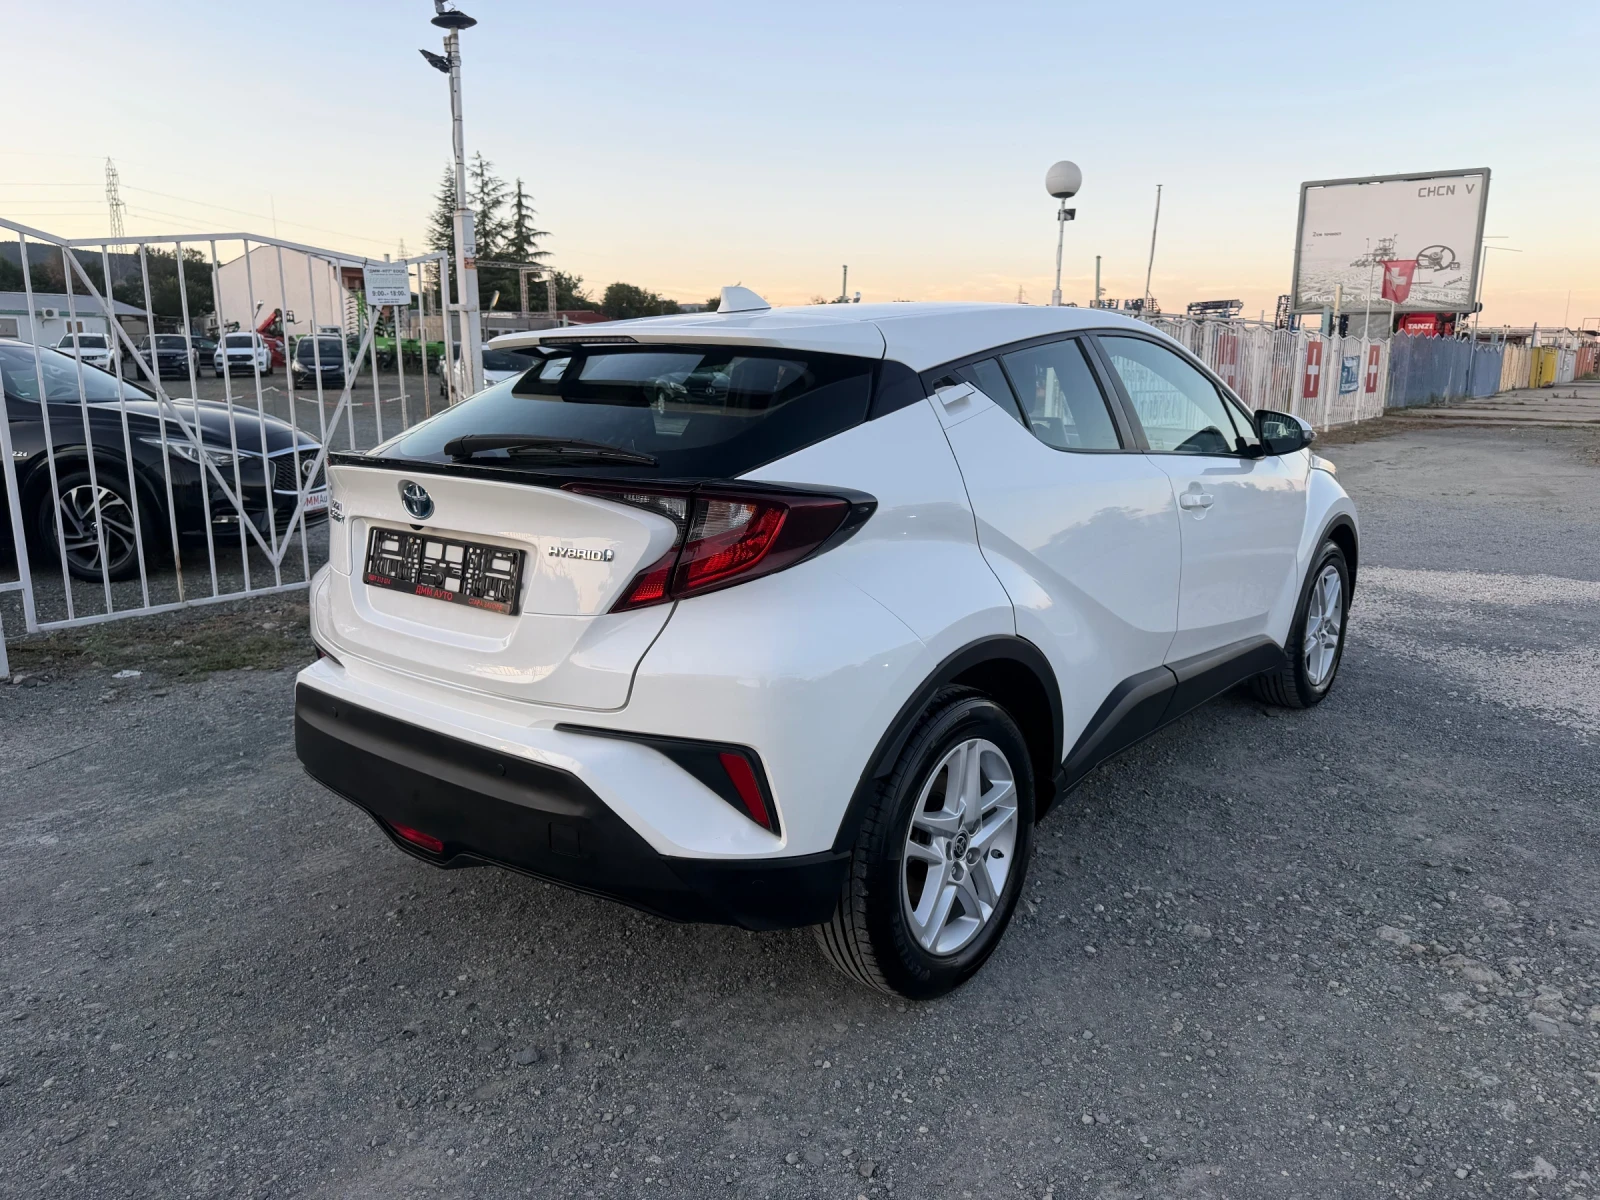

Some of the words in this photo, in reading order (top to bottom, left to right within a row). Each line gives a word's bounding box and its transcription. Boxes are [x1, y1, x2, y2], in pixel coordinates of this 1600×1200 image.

[548, 546, 602, 561] HYBRID
[415, 584, 433, 597] ДММ
[434, 589, 453, 601] АУТО
